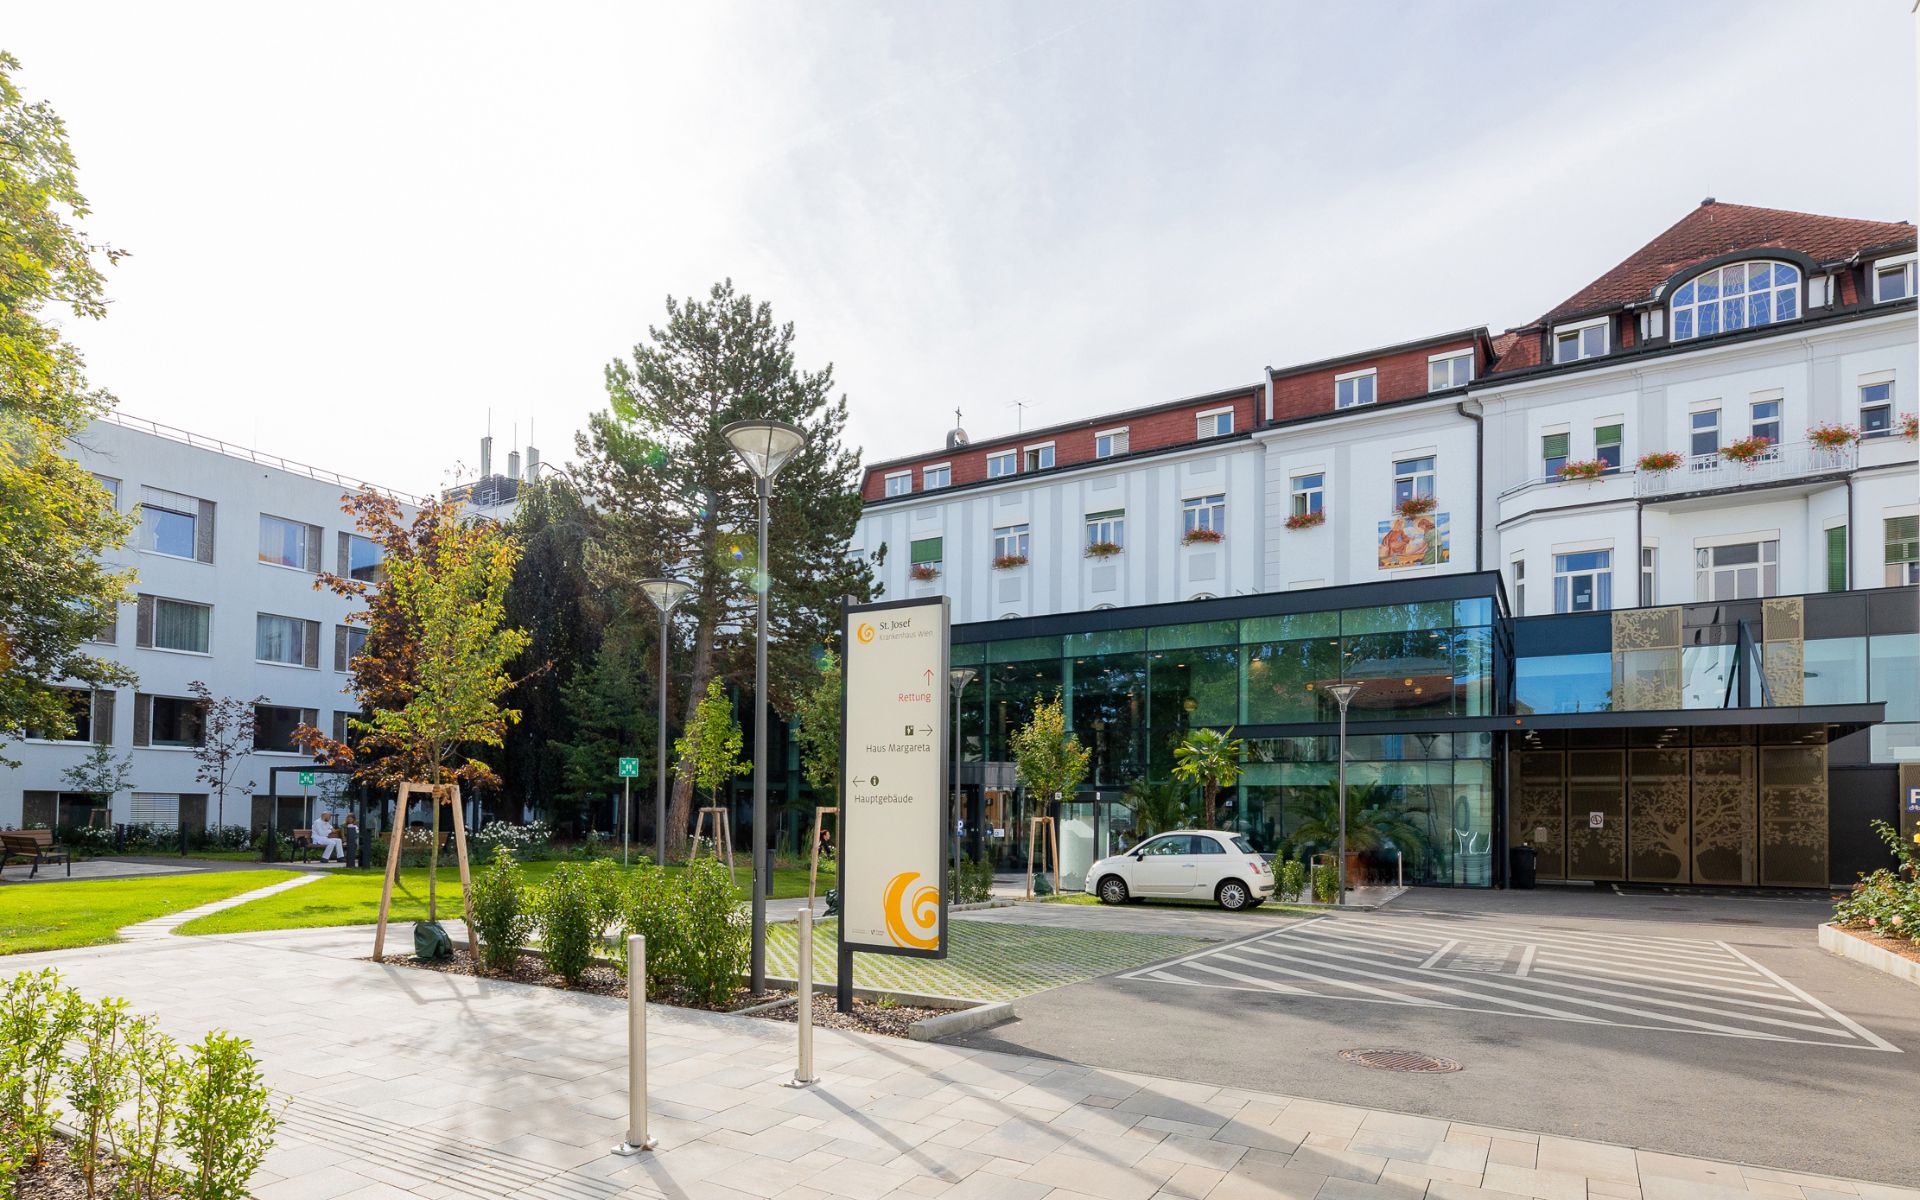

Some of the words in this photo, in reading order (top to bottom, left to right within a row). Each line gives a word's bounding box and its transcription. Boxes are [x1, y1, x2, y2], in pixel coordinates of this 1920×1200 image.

[880, 621, 889, 631] St.
[891, 618, 911, 630] Josef
[898, 693, 931, 703] Rettung
[866, 744, 886, 753] Haus
[888, 743, 931, 754] Margareta
[854, 794, 913, 805] Hauptgebäude
